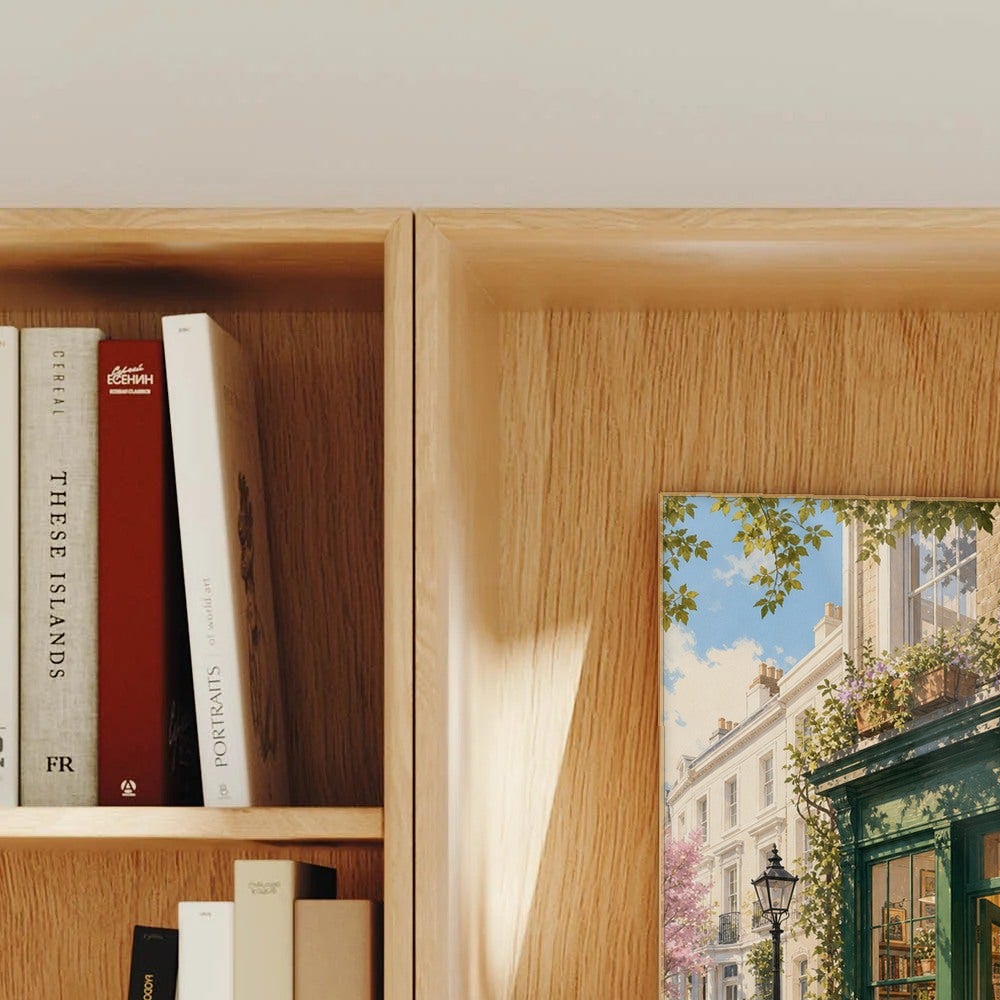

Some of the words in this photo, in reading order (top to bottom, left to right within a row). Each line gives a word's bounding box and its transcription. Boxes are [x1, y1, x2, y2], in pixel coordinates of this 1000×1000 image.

[53, 350, 65, 416] CEREAL
[107, 374, 154, 385] ЕСЕНИН
[50, 471, 67, 558] THESE
[49, 572, 66, 679] ISLANDS
[207, 665, 228, 768] PORTRAITS
[46, 756, 75, 773] FR
